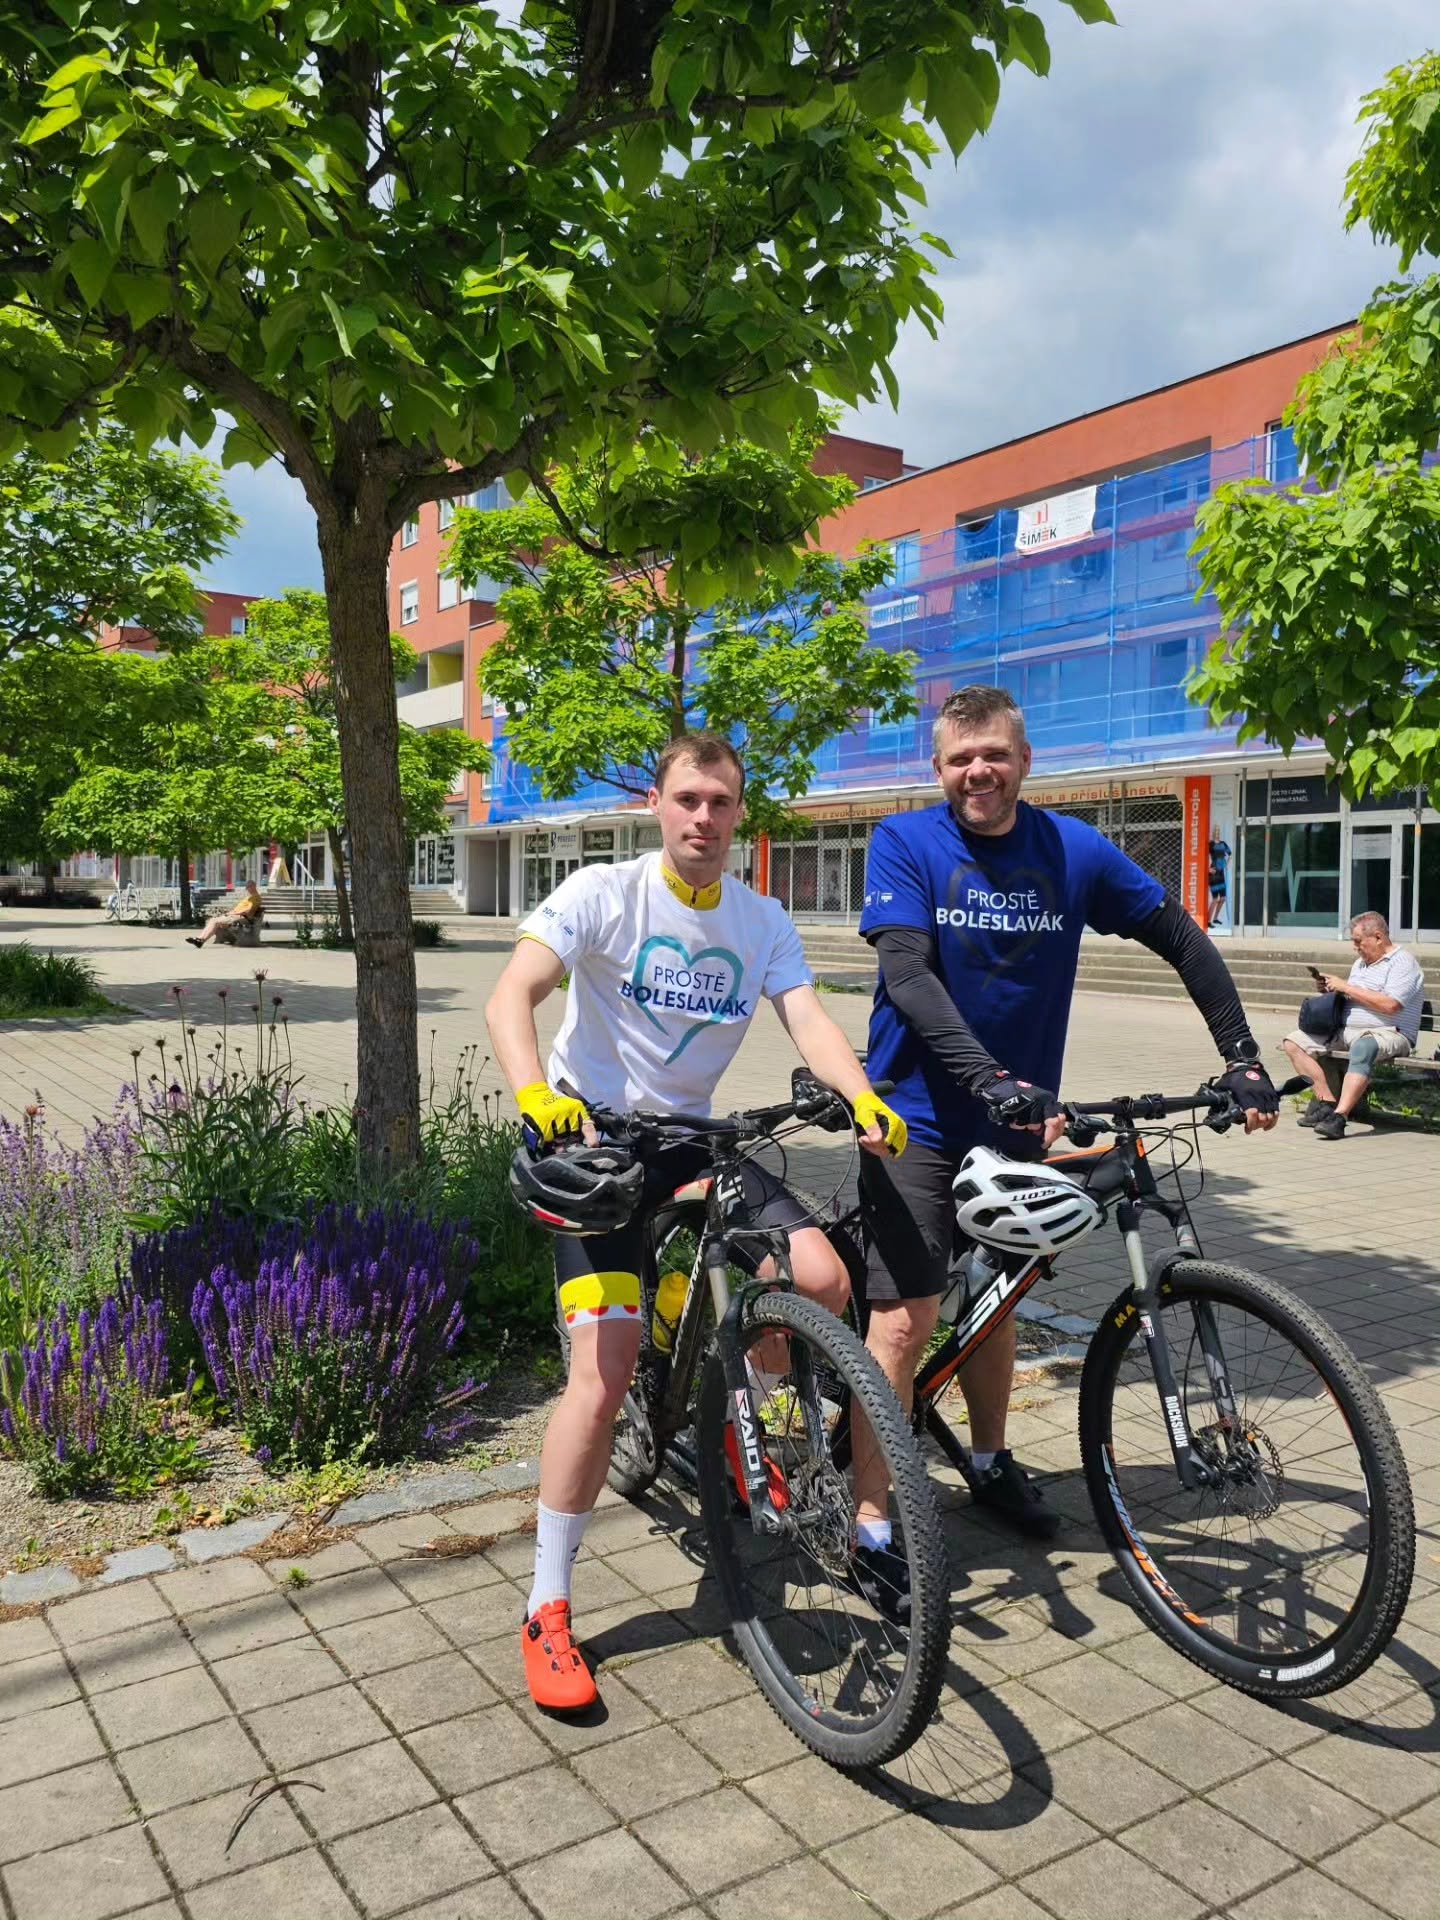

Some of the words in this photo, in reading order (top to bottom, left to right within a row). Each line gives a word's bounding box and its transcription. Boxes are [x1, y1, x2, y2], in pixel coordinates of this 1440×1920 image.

[1020, 528, 1057, 545] ŠIMEK
[967, 889, 1040, 910] PROSTĚ
[936, 907, 1064, 932] BOLESLAVÁK
[654, 965, 727, 993] PROSTĚ
[620, 980, 749, 1017] BOLESLAVÁK
[1012, 1188, 1057, 1202] SCOTT
[1164, 1395, 1189, 1449] ROCKSHOX
